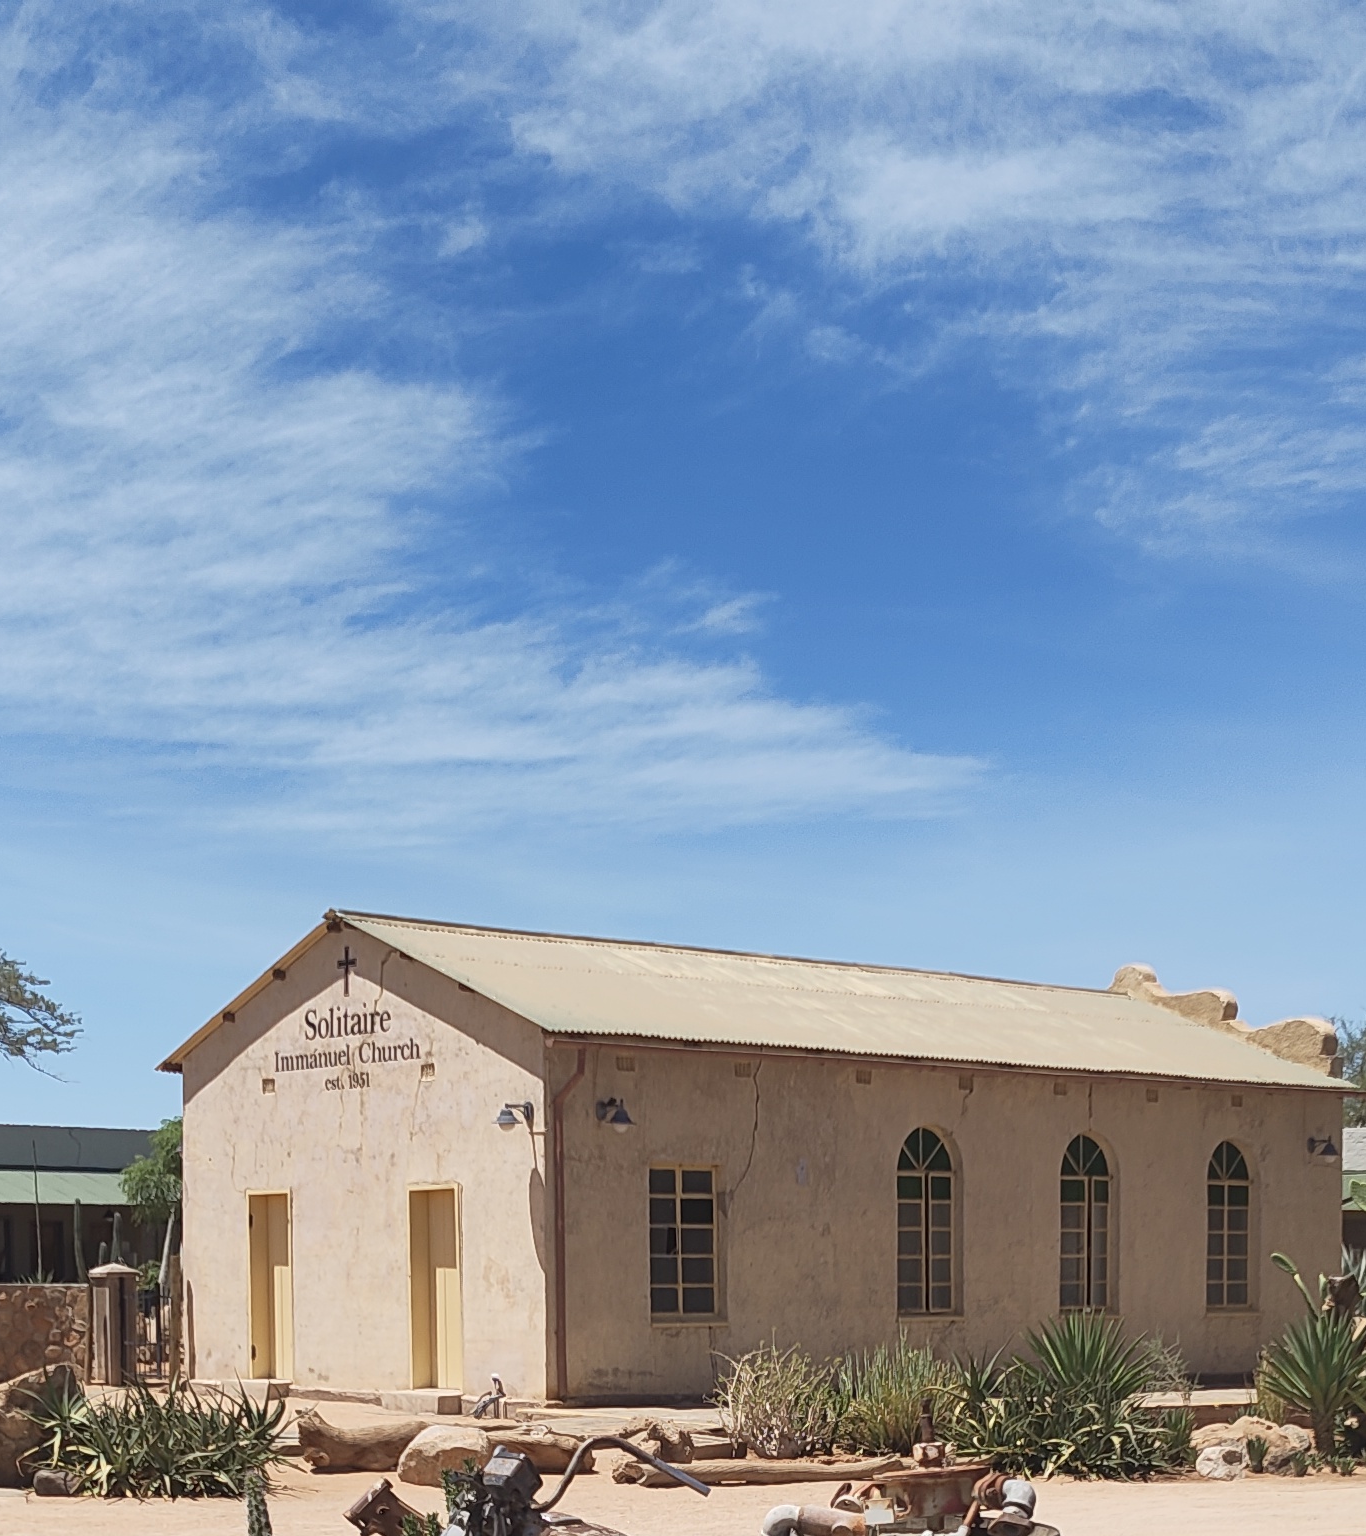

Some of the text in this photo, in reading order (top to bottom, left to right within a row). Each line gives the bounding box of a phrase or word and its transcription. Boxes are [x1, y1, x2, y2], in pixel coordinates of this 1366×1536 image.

[304, 1002, 391, 1041] Solitaire
[357, 1037, 422, 1065] Church
[347, 1071, 371, 1091] 1951
